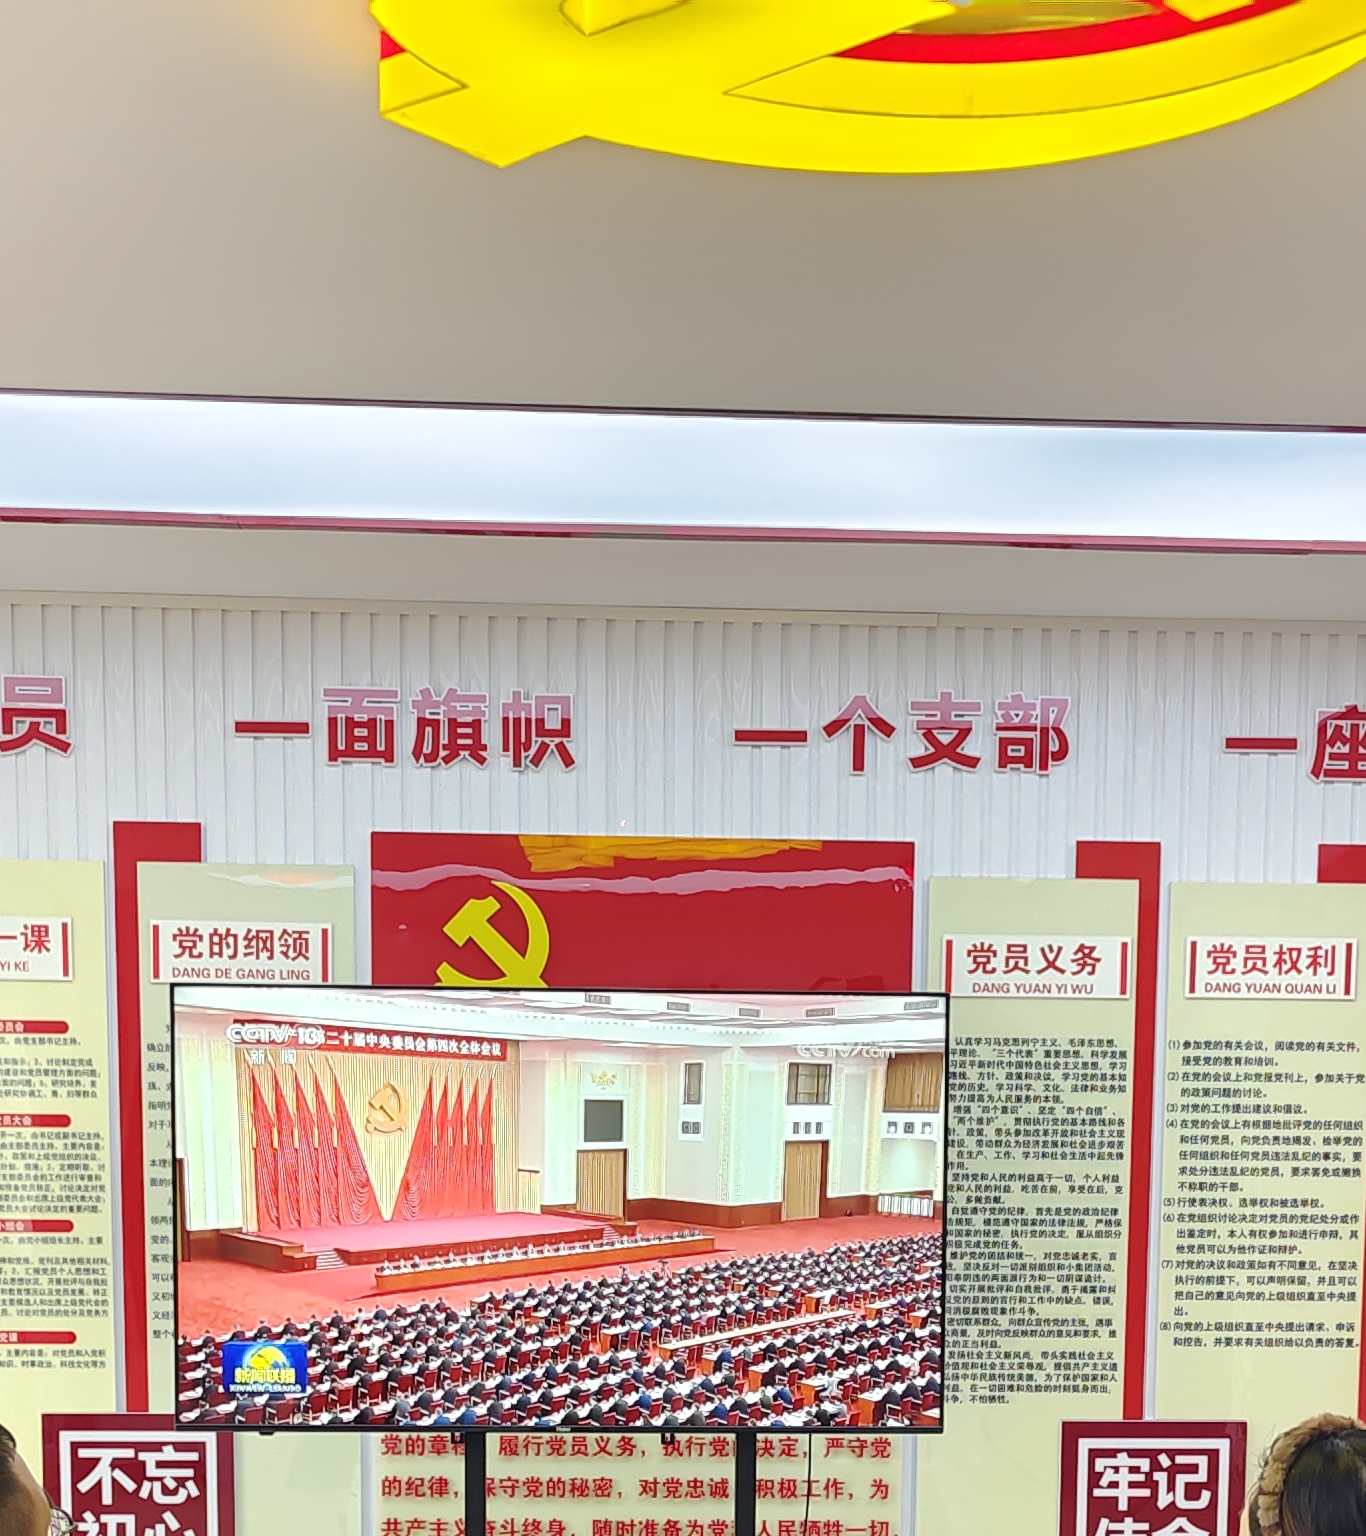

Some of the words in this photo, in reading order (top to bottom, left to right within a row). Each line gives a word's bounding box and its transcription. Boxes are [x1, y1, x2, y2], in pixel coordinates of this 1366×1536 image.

[234, 687, 576, 771] 一面旗帜
[733, 691, 1071, 774] 一个支部
[172, 926, 310, 962] 党的纲领
[0, 961, 11, 972] YI
[15, 962, 30, 972] KE
[967, 942, 1102, 976] 党员义务
[1206, 943, 1336, 976] 党员权利
[172, 967, 211, 979] DANG
[215, 968, 232, 979] DE
[236, 968, 275, 981] GANG
[280, 969, 310, 981] LING
[972, 982, 1010, 993] DANG
[1015, 983, 1052, 994] YUAN
[1055, 984, 1068, 994] YI
[1071, 984, 1094, 994] WU
[1204, 982, 1241, 994] DANG
[1245, 983, 1281, 994] YUAN
[1284, 983, 1322, 994] QUAN
[1326, 984, 1336, 994] LI
[250, 1049, 297, 1065] 新闻
[149, 1159, 172, 1168] 本理
[77, 1445, 201, 1506] 不忘
[1092, 1452, 1212, 1511] 牢记
